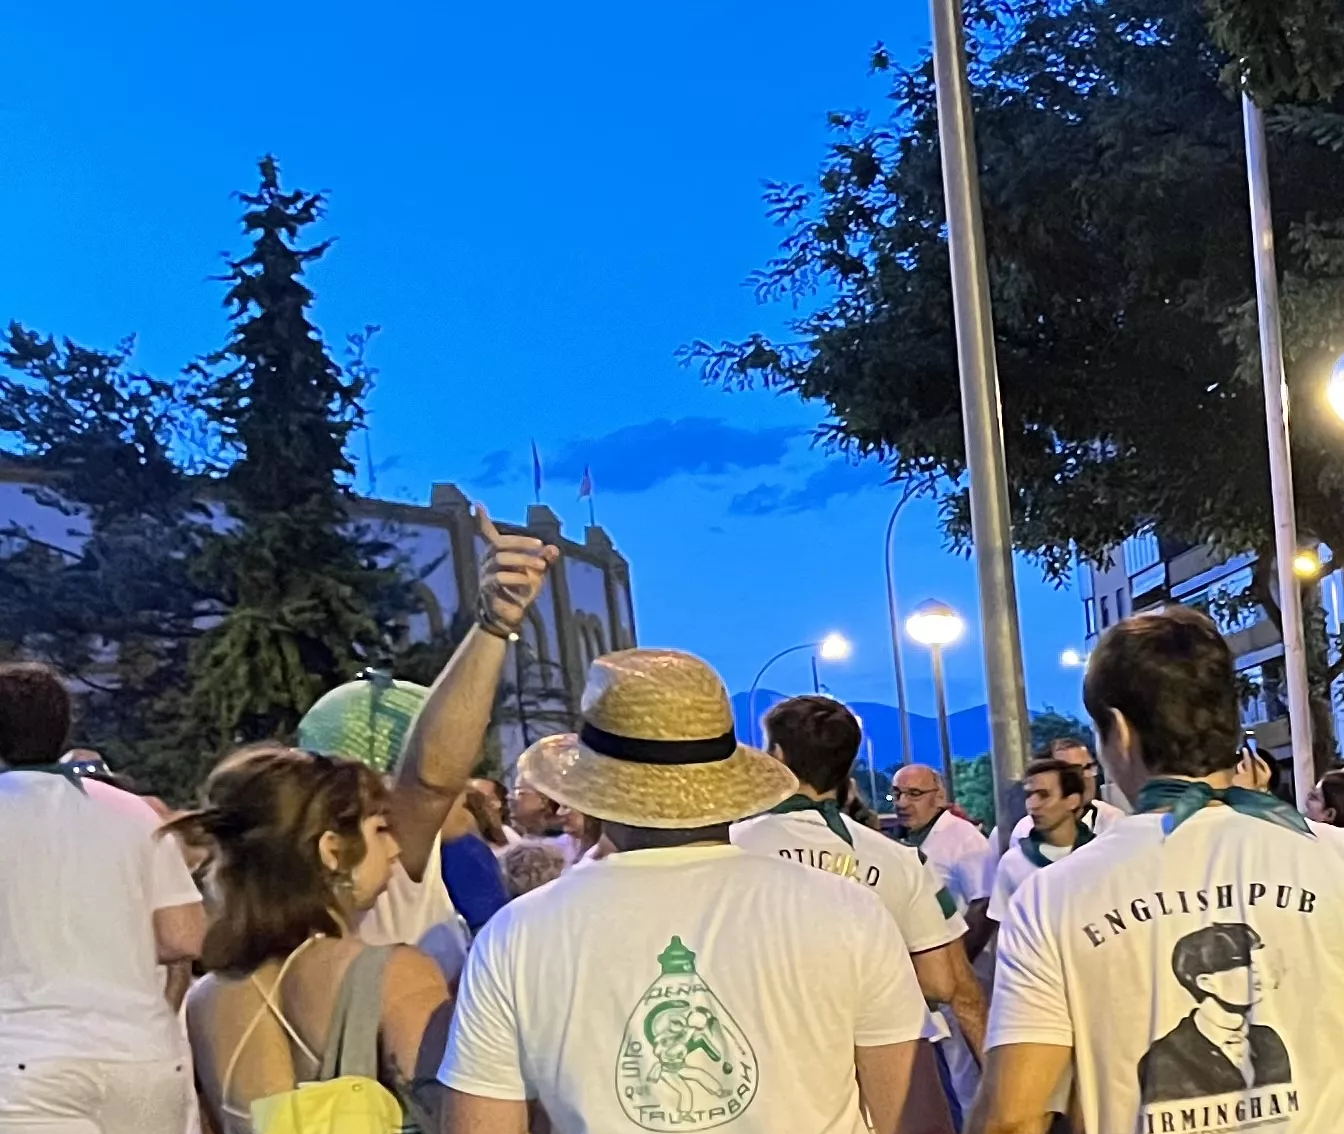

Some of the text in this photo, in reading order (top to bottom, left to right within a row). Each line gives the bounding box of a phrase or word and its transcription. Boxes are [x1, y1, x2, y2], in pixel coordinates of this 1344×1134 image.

[1082, 883, 1317, 948] ENGLISH PUB
[1143, 1090, 1299, 1134] IRMINGHAM
